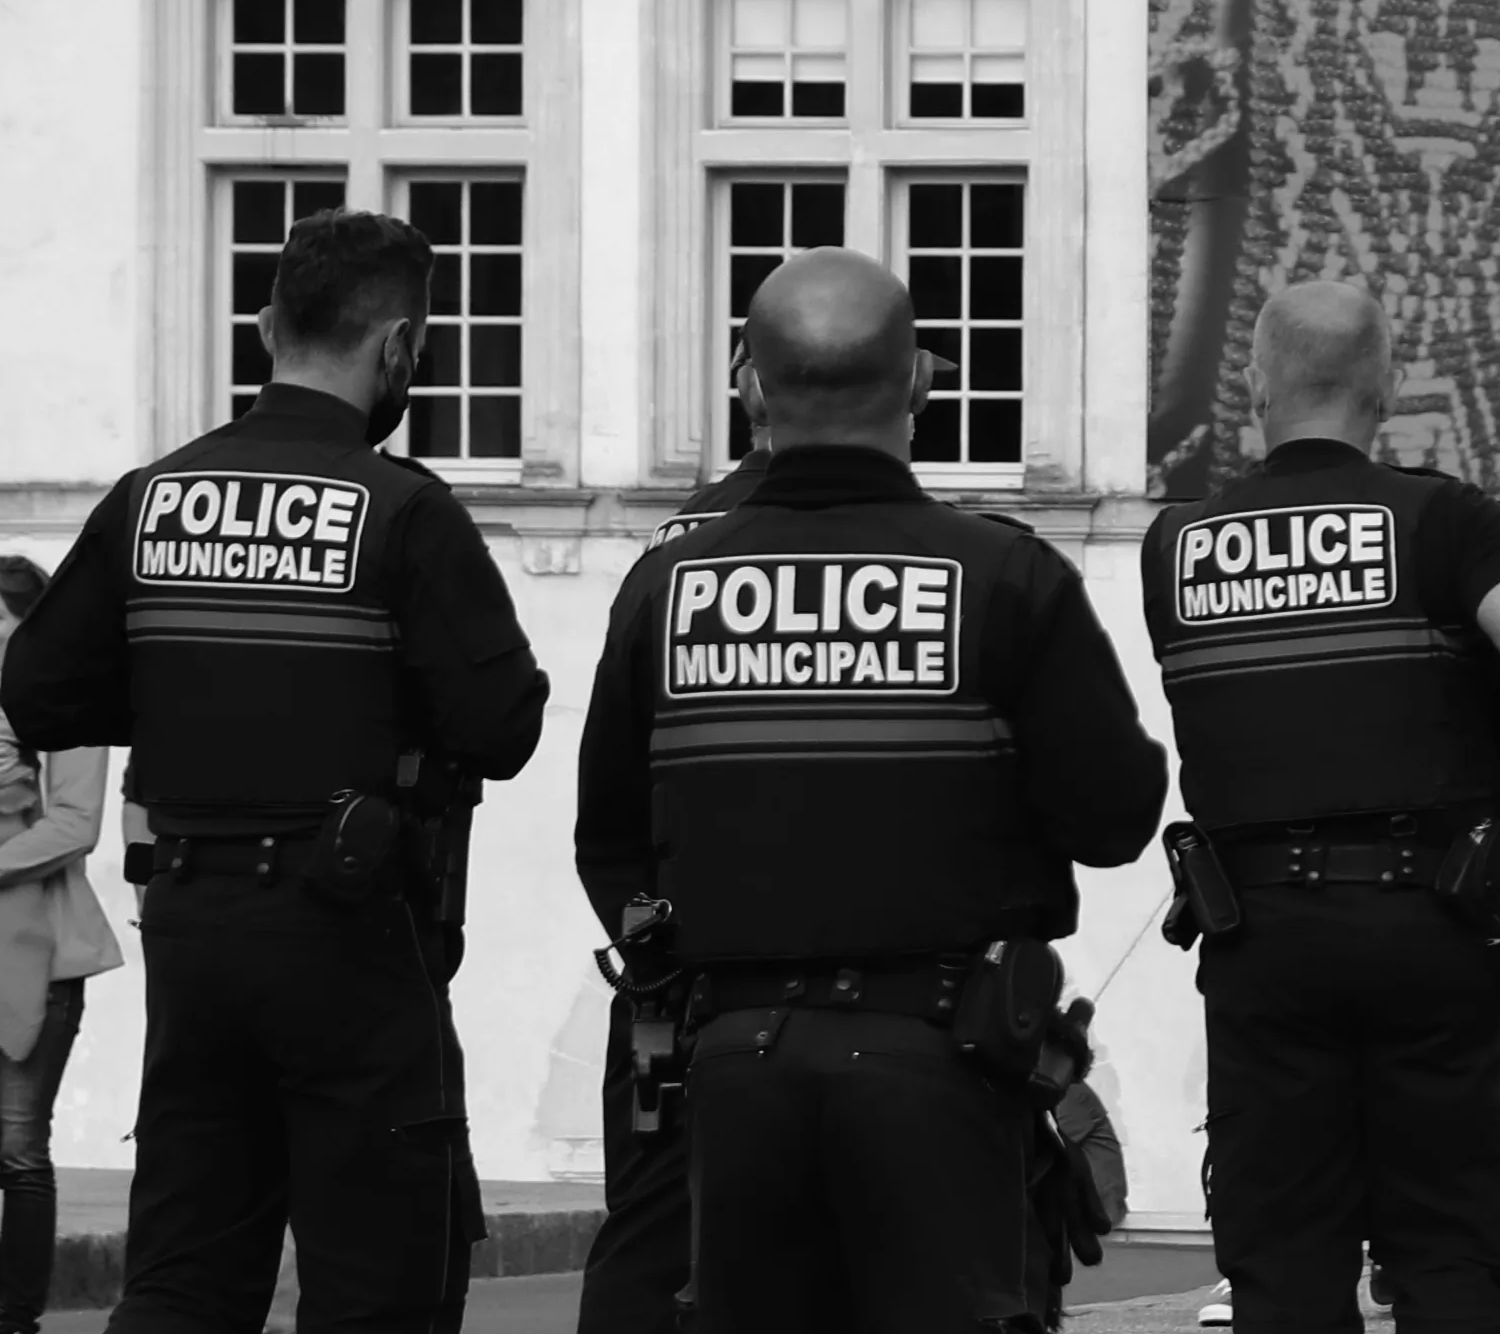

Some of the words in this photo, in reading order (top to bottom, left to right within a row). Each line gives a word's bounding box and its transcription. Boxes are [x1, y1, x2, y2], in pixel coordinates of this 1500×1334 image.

[144, 480, 359, 543] POLICE
[142, 541, 347, 584] MUNICIPALE
[1183, 512, 1384, 580] POLICE
[675, 564, 949, 636] POLICE
[1184, 568, 1386, 618] MUNICIPALE
[675, 641, 945, 686] MUNICIPALE
